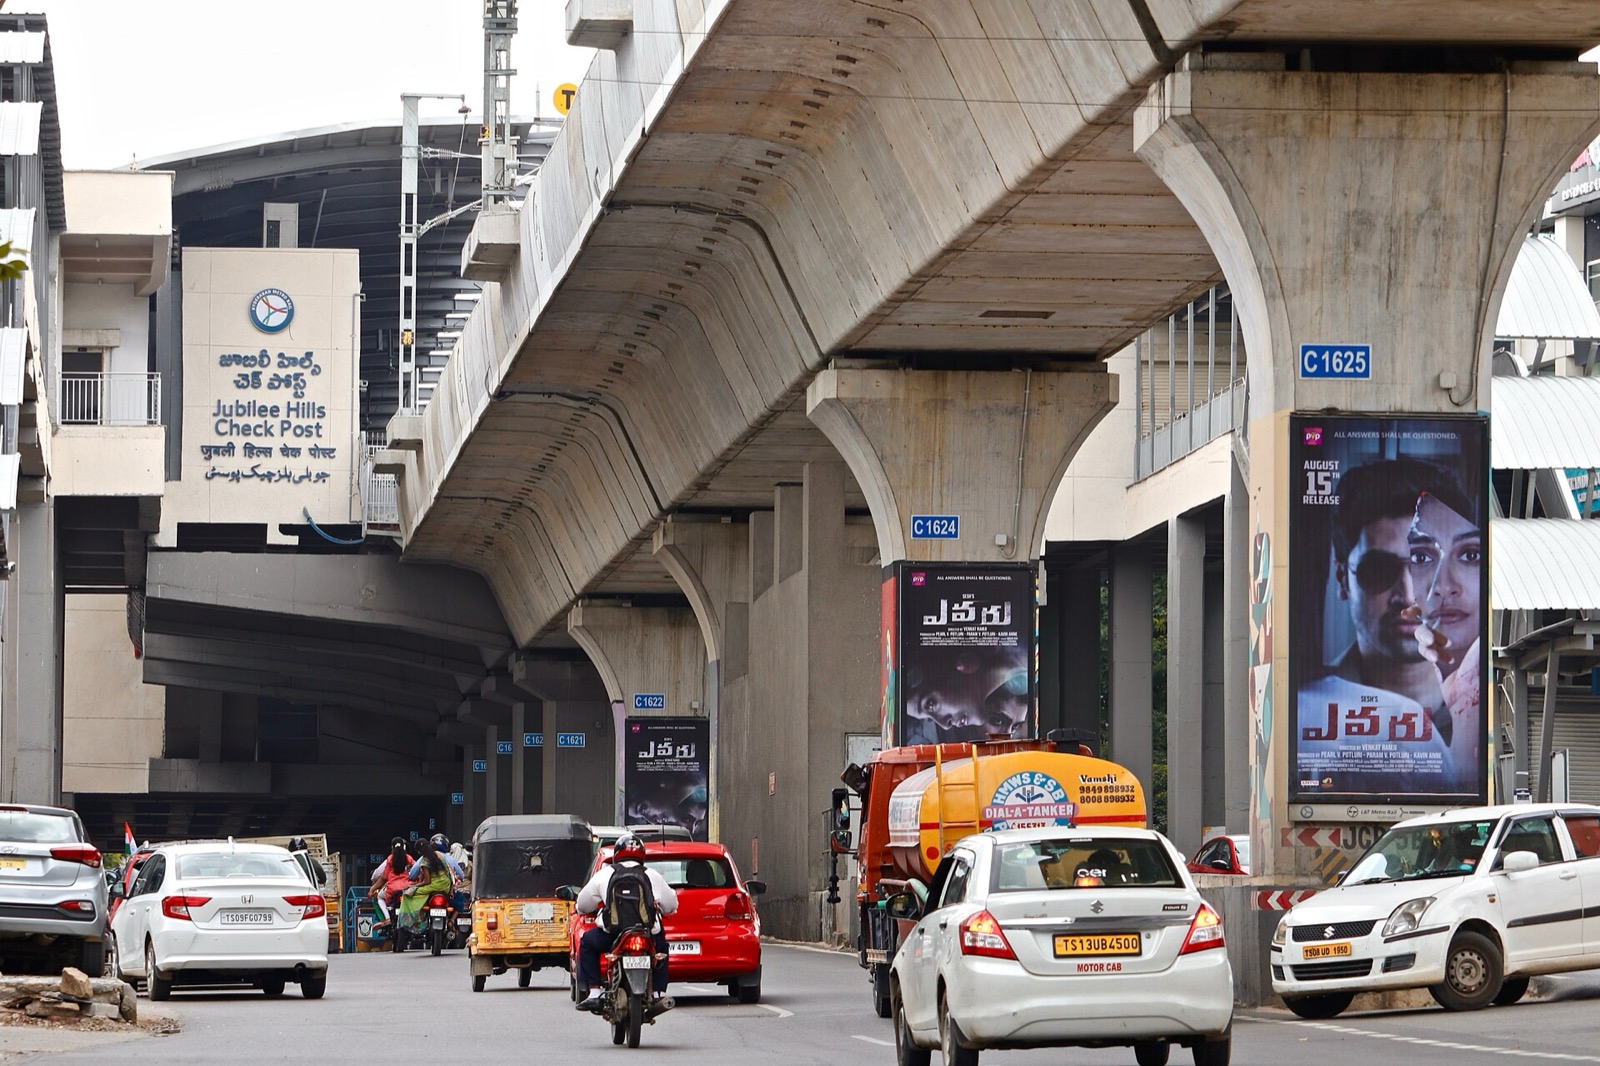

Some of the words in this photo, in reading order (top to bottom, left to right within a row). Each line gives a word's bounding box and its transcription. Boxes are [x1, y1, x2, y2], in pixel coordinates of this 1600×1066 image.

[219, 349, 271, 368] జూబిలీ
[277, 351, 321, 376] హిల్స్
[1304, 350, 1318, 373] C
[1321, 350, 1366, 373] 1625
[233, 371, 263, 389] చెక్
[267, 372, 307, 399] పోస్ట్
[212, 399, 281, 419] Jubilee
[287, 401, 326, 419] Hills
[214, 418, 274, 437] Check
[280, 420, 322, 438] Post
[1347, 431, 1380, 439] ANSWERS
[1412, 432, 1458, 440] QUESTIONED.
[201, 441, 236, 460] जुबली
[243, 442, 273, 458] हिल्स
[280, 444, 302, 458] चेक
[308, 444, 336, 459] पोस्ट
[1303, 460, 1340, 470] AUGUST
[1303, 495, 1340, 505] RELEASE
[914, 520, 923, 534] C
[926, 520, 956, 534] 1624
[636, 697, 642, 707] C
[644, 697, 663, 707] 1622
[1361, 695, 1378, 703] SESH'S
[525, 736, 531, 745] C
[531, 736, 543, 745] 162
[559, 736, 565, 745] C
[566, 736, 583, 745] 1621
[498, 743, 504, 752] C
[1080, 774, 1118, 785] Vamshi
[993, 772, 1031, 805] HMWS
[1033, 772, 1045, 785] &
[1044, 778, 1066, 800] SB
[985, 803, 1074, 819] DIAL-A-TANKER
[1063, 938, 1138, 951] TS13UB4500
[1305, 947, 1321, 957] TS08
[1321, 947, 1330, 955] UD
[1333, 945, 1348, 955] 1950
[1077, 963, 1104, 972] MOTOR
[1106, 963, 1122, 972] CAB
